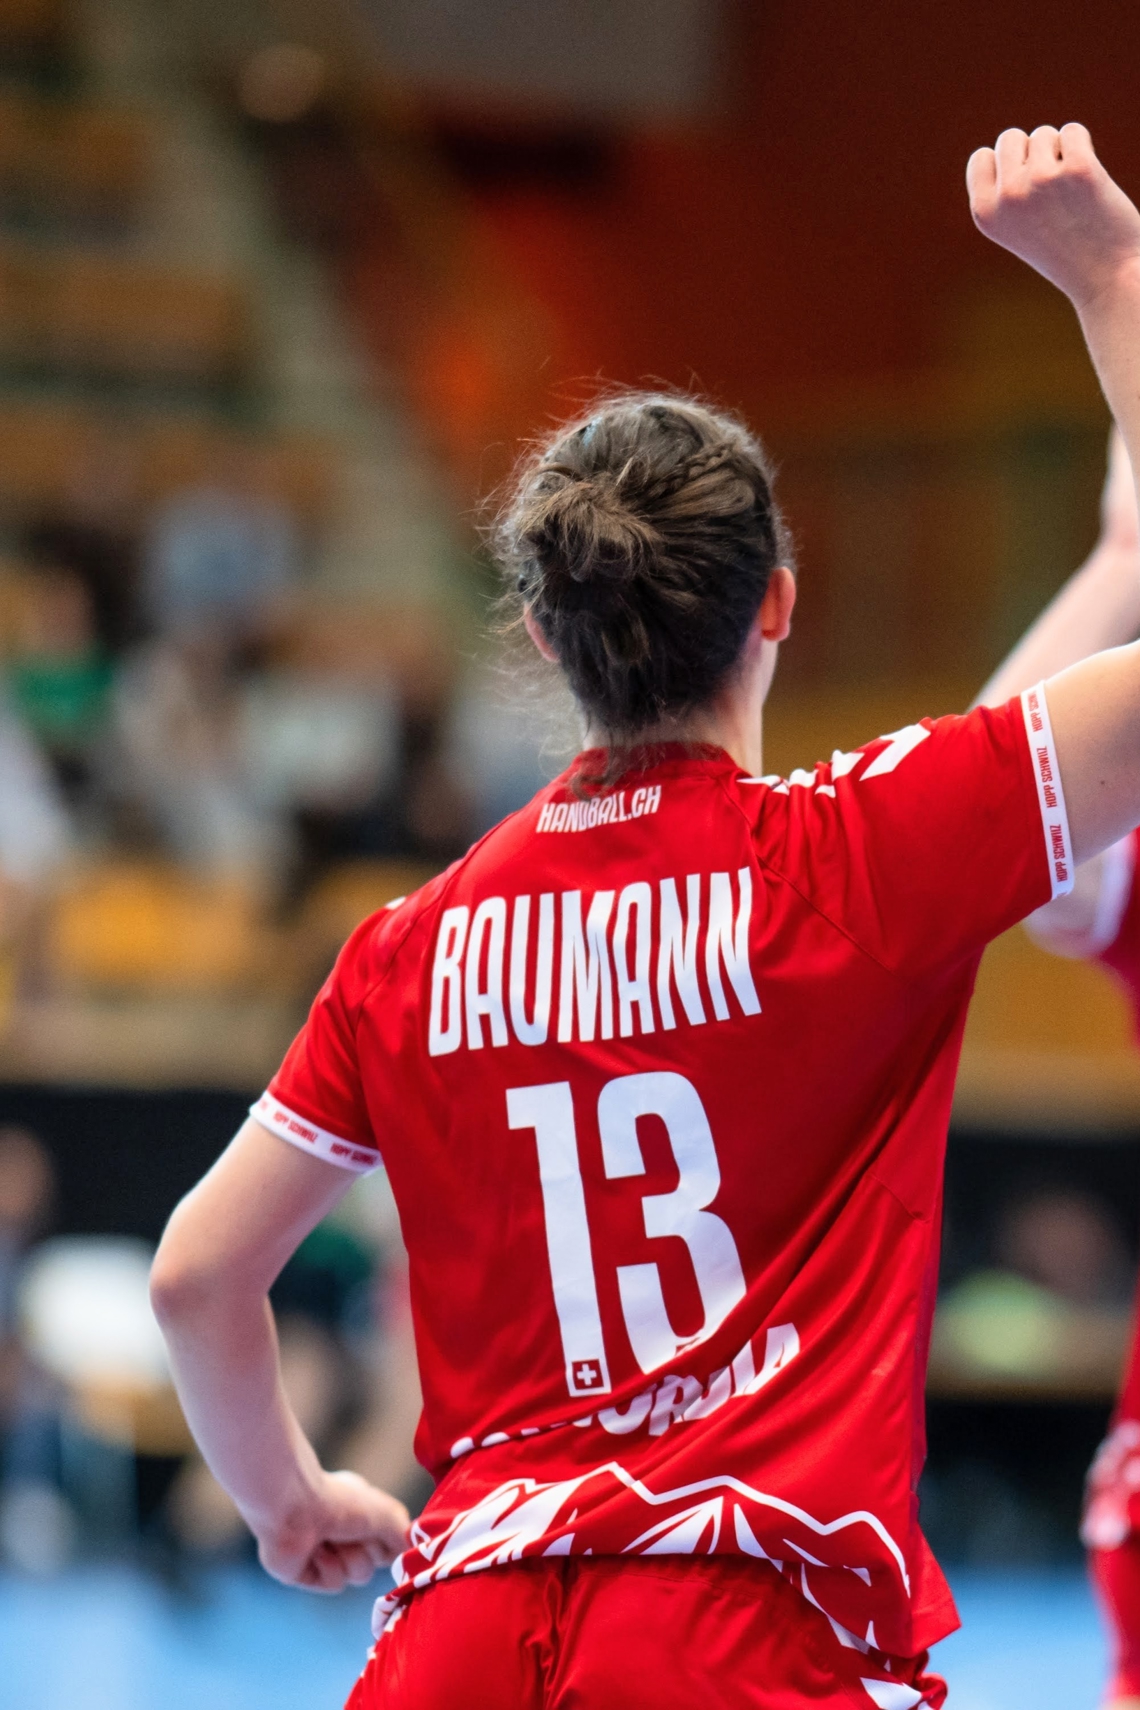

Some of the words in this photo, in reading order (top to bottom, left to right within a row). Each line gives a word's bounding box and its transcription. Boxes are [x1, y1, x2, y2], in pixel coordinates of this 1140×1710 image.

[1037, 746, 1053, 783] SCHWIIZ
[536, 785, 661, 833] HANDBALL.CH
[1043, 785, 1057, 808] HOPP
[1050, 824, 1066, 861] SCHWIIZ
[1055, 861, 1068, 883] HOPP
[428, 866, 762, 1057] BAUMANN
[505, 1071, 747, 1397] 13
